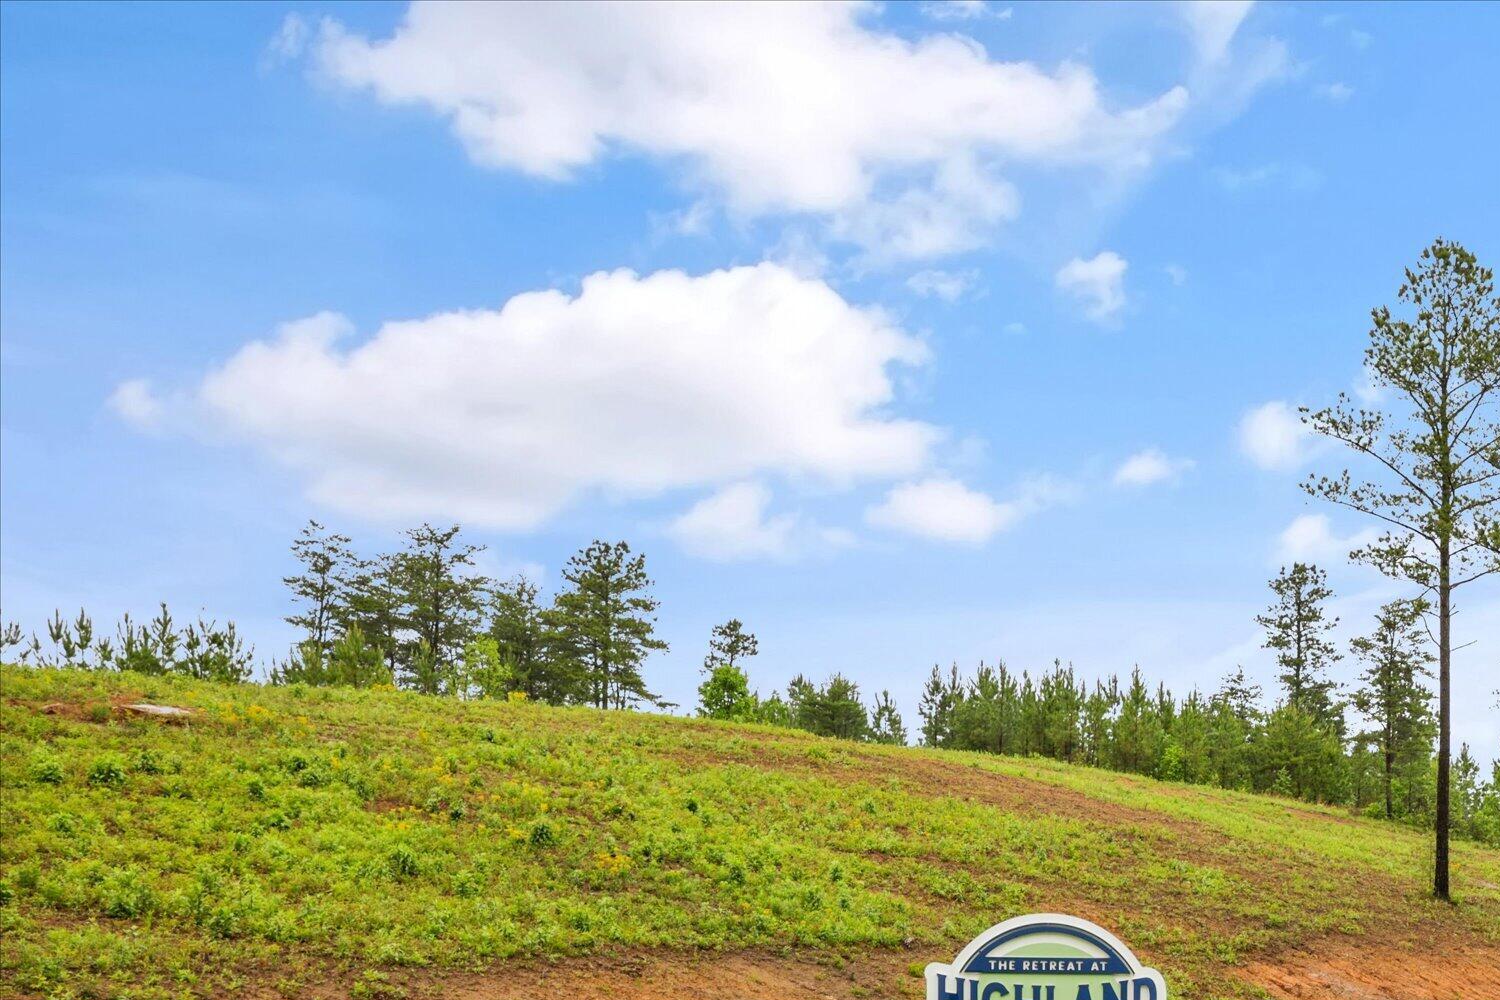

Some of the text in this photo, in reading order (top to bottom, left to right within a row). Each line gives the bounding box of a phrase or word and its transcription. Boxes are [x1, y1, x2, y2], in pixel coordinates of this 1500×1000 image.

[988, 960, 1108, 971] THE RETREAT AT
